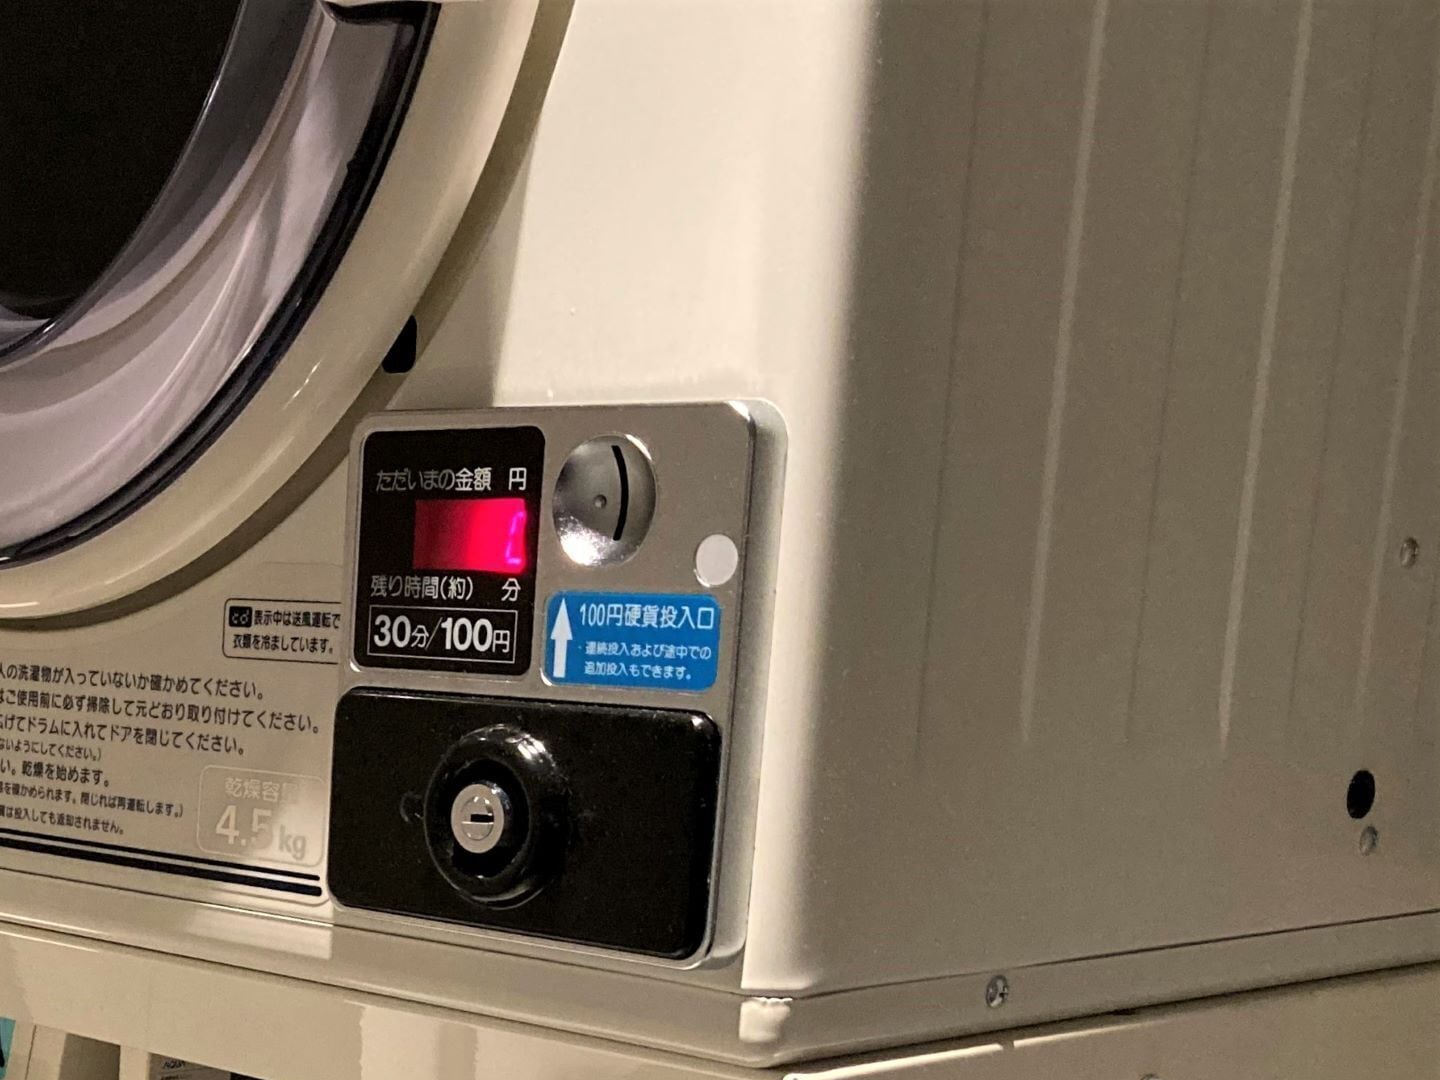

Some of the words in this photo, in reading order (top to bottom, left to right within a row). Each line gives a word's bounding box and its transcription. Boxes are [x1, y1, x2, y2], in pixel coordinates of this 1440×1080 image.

[375, 466, 492, 492] ただいまの金額
[508, 467, 527, 491] 円
[371, 575, 474, 601] 残り時間(約)
[501, 578, 521, 601] 分
[579, 602, 715, 630] 100円硬貨投入口
[233, 633, 333, 654] 衣類を冷ましています。
[373, 614, 510, 654] 30分/100円
[584, 640, 712, 661] 連続投入および途中での
[584, 660, 692, 681] 追加投入もできます。
